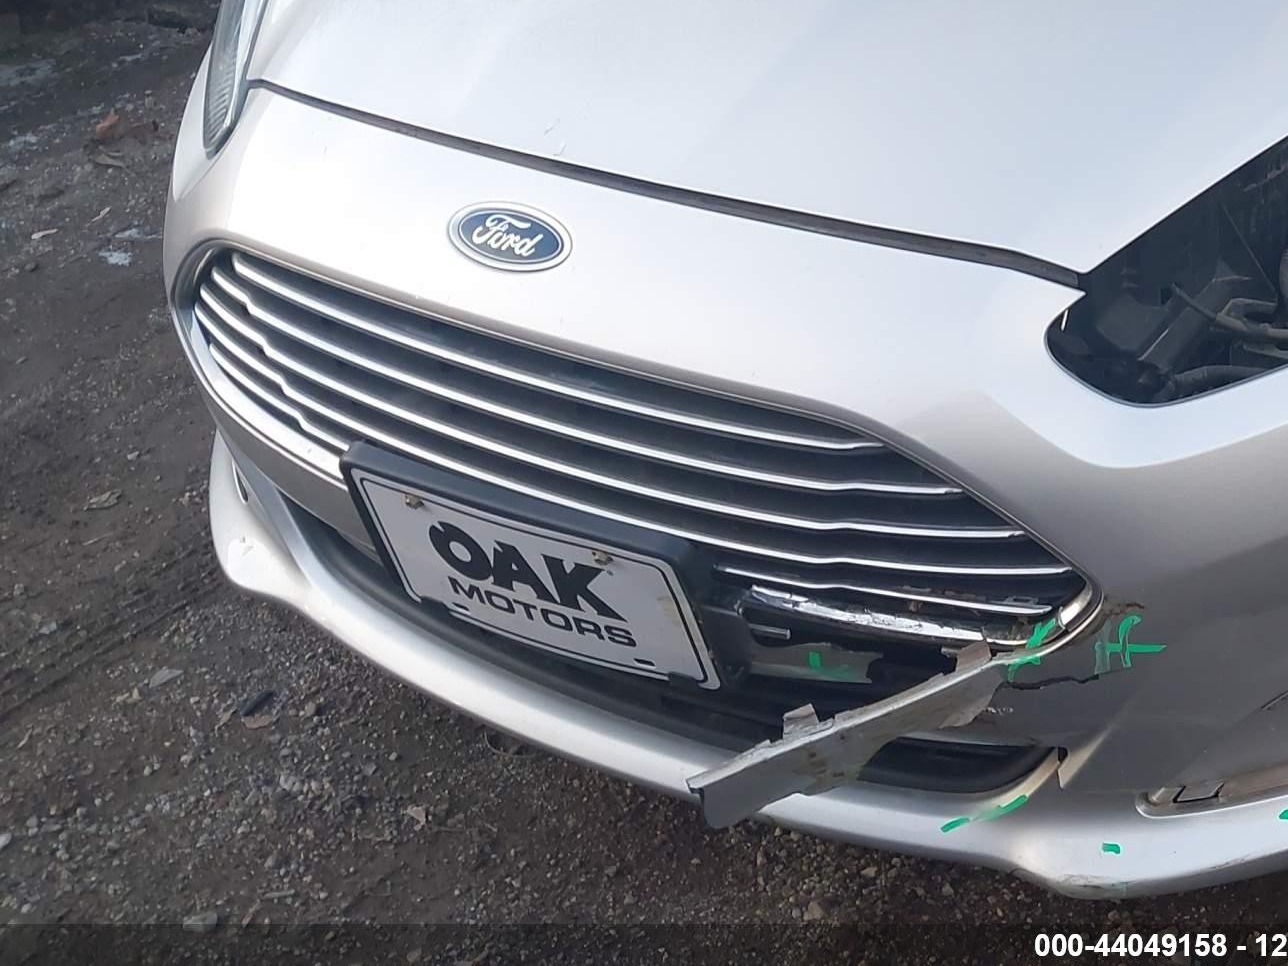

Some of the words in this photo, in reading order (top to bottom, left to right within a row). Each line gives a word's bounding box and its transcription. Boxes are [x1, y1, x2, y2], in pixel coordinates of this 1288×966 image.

[472, 214, 544, 257] Ford
[428, 521, 628, 622] OAK
[447, 576, 637, 648] MOTORS
